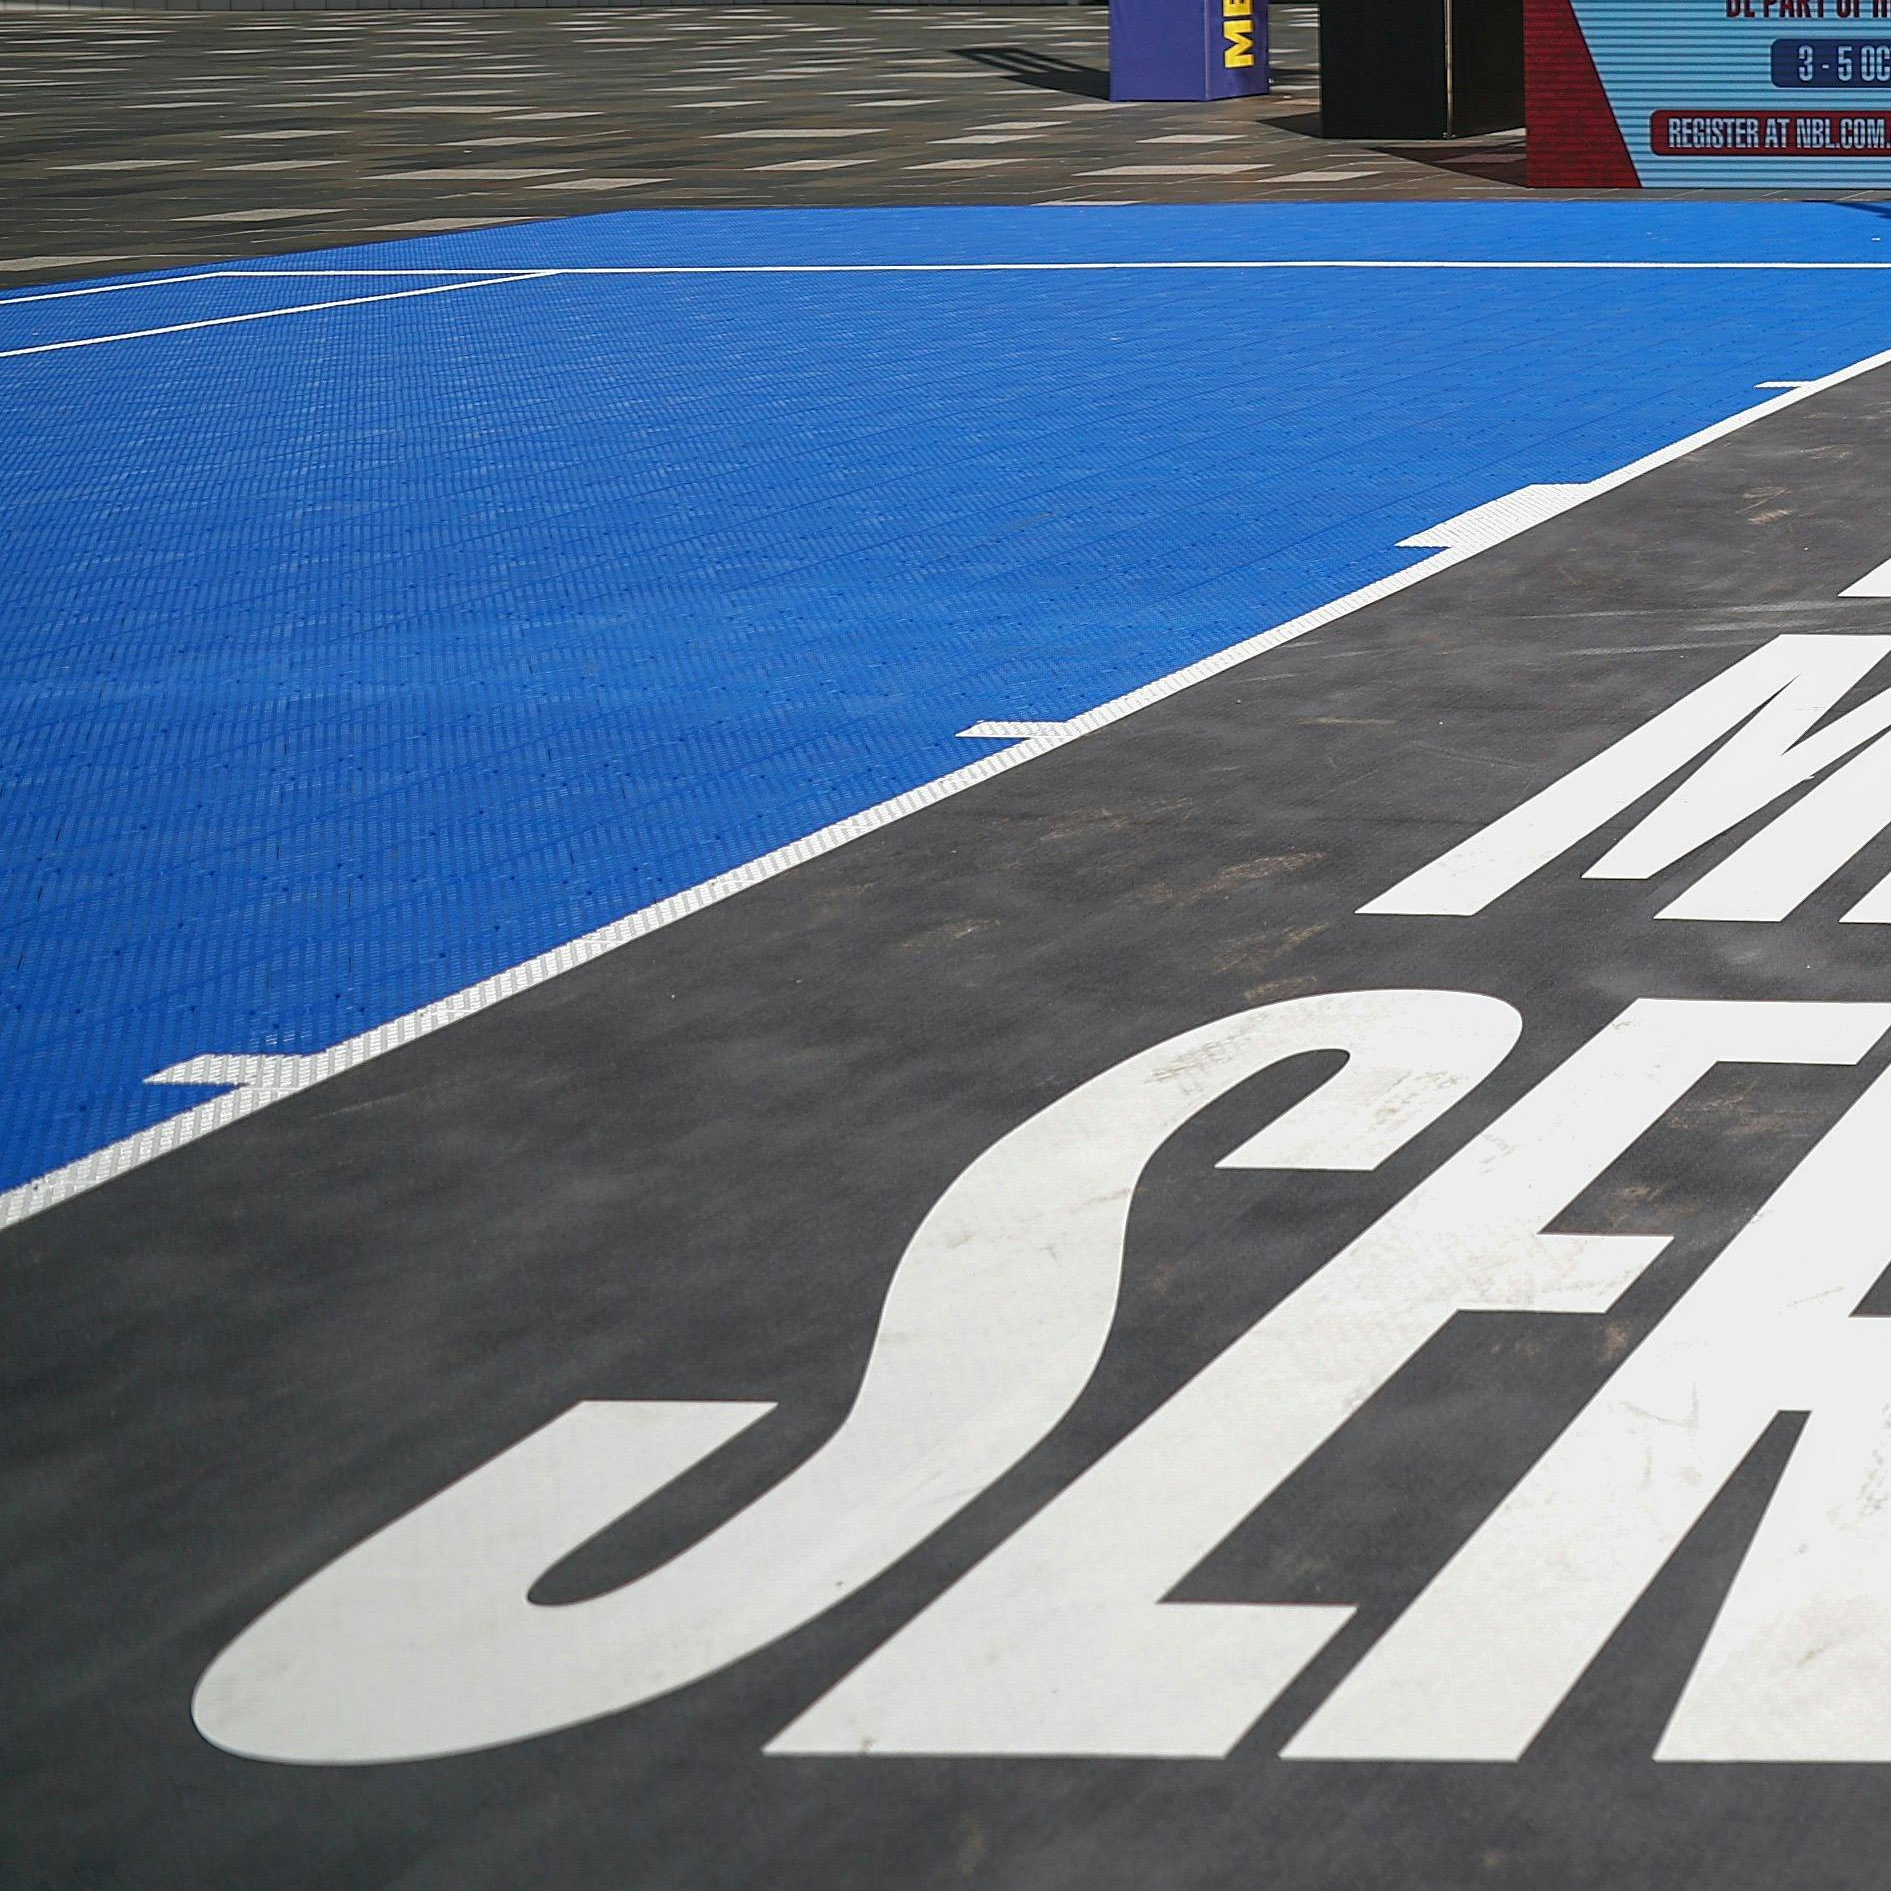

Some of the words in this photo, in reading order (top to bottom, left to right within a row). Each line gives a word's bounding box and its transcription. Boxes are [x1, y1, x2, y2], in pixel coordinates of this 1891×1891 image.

[1797, 45, 1814, 82] 3
[1837, 45, 1852, 82] 5
[1668, 117, 1759, 149] REGISTER
[1764, 117, 1790, 149] AT
